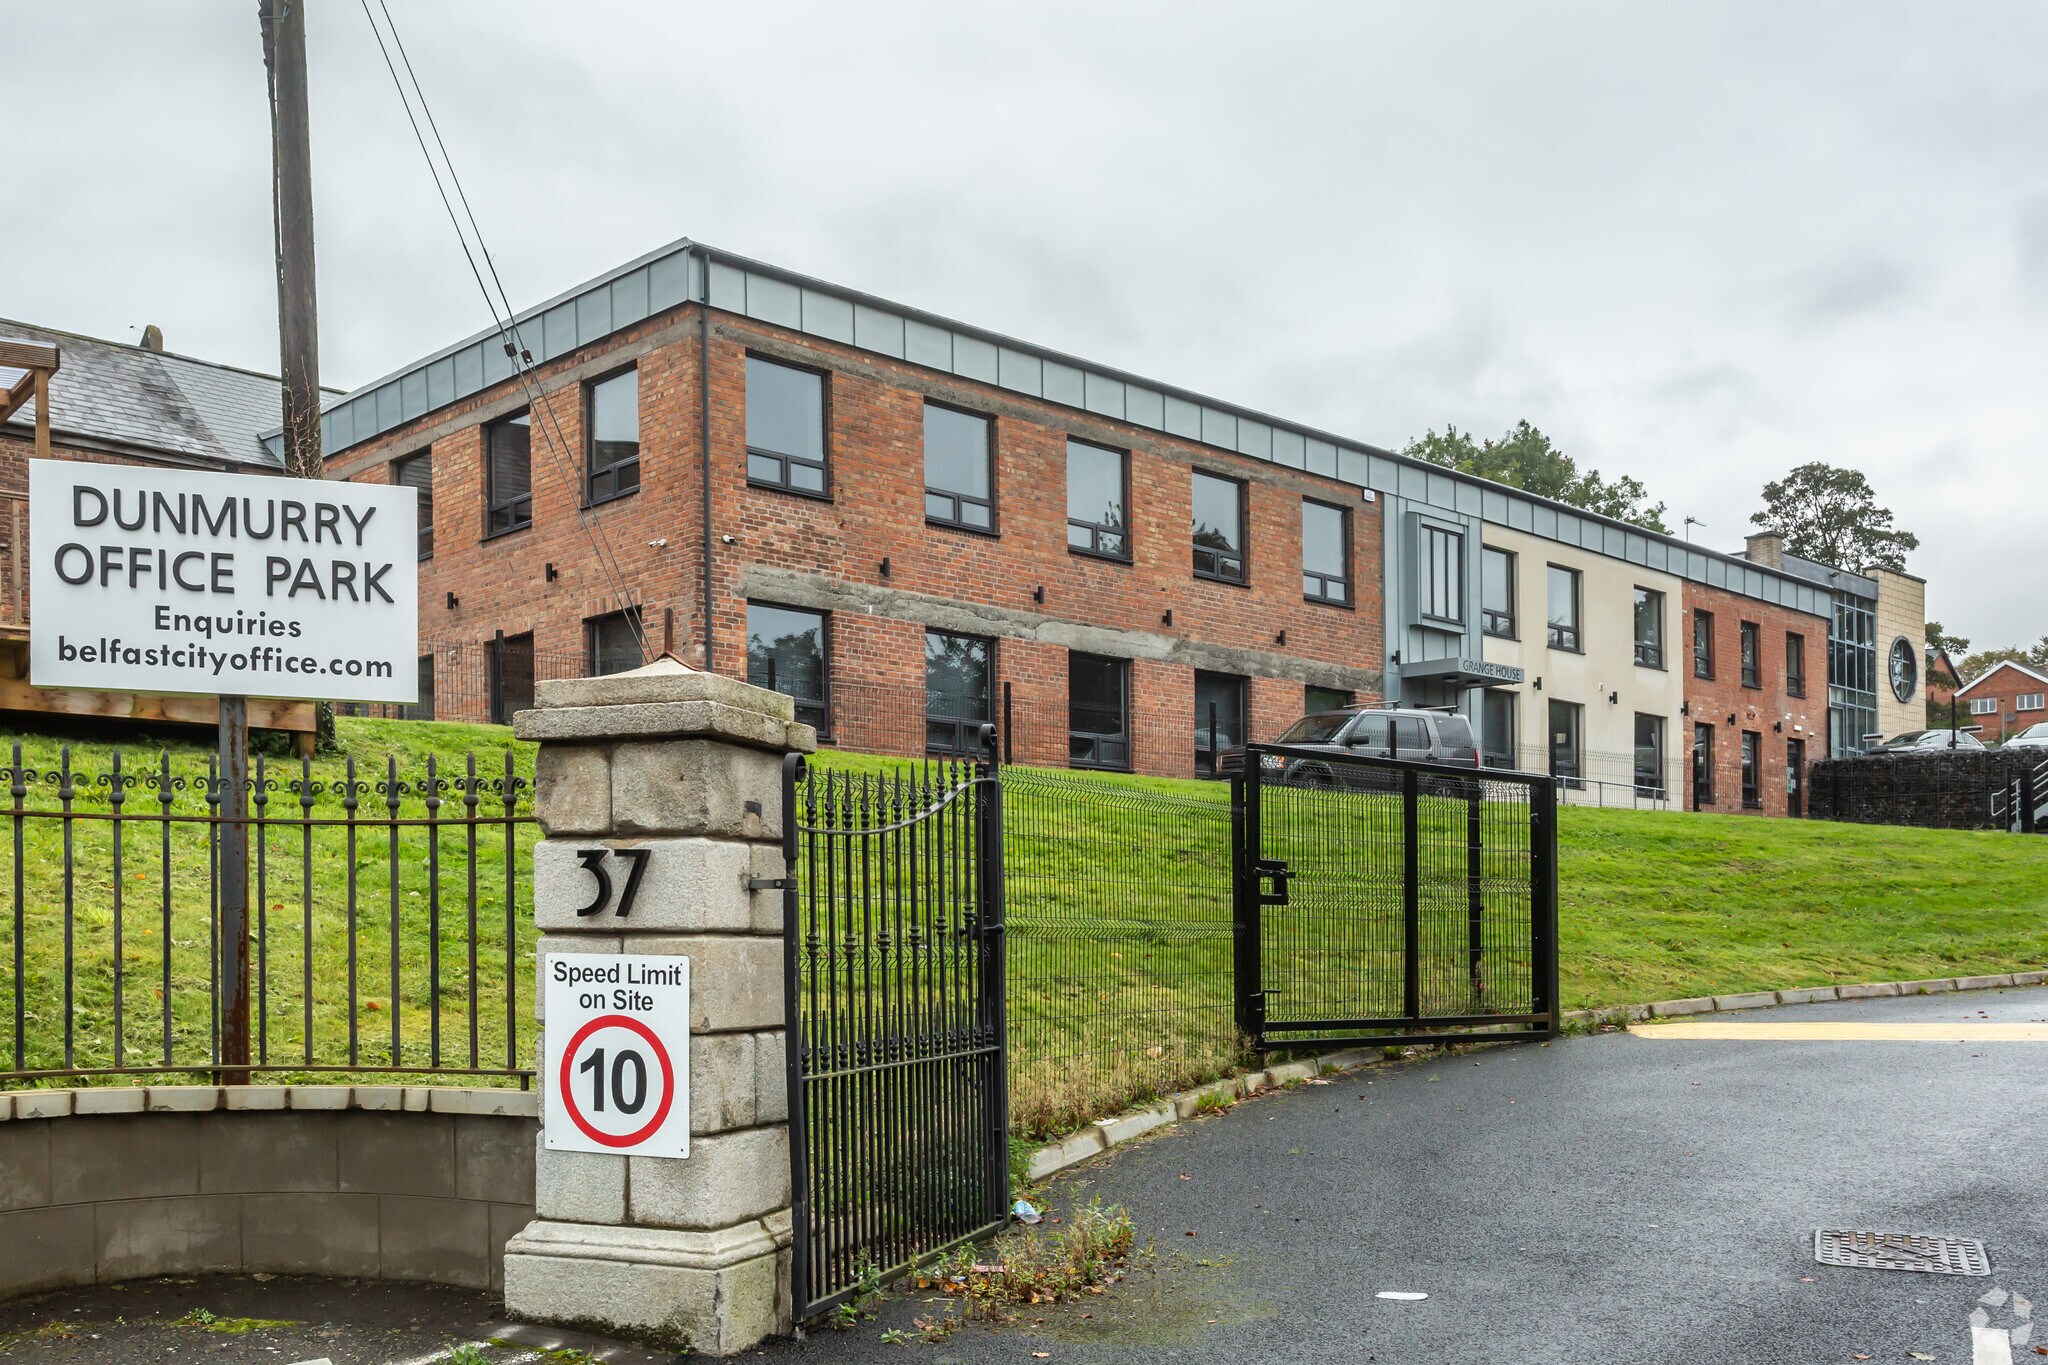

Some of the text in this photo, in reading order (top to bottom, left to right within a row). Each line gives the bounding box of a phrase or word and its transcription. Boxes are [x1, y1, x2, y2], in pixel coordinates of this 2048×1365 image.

[73, 485, 377, 546] DUNMURRY
[54, 542, 394, 603] OFFICE PARK
[155, 605, 302, 639] Enquiries
[58, 636, 392, 678] belfastcityoffice.com
[1463, 660, 1520, 680] GRANGE HOUSE
[577, 849, 651, 916] 37
[553, 961, 682, 988] Speed Limit
[579, 989, 654, 1011] on Site
[580, 1048, 647, 1115] 10
